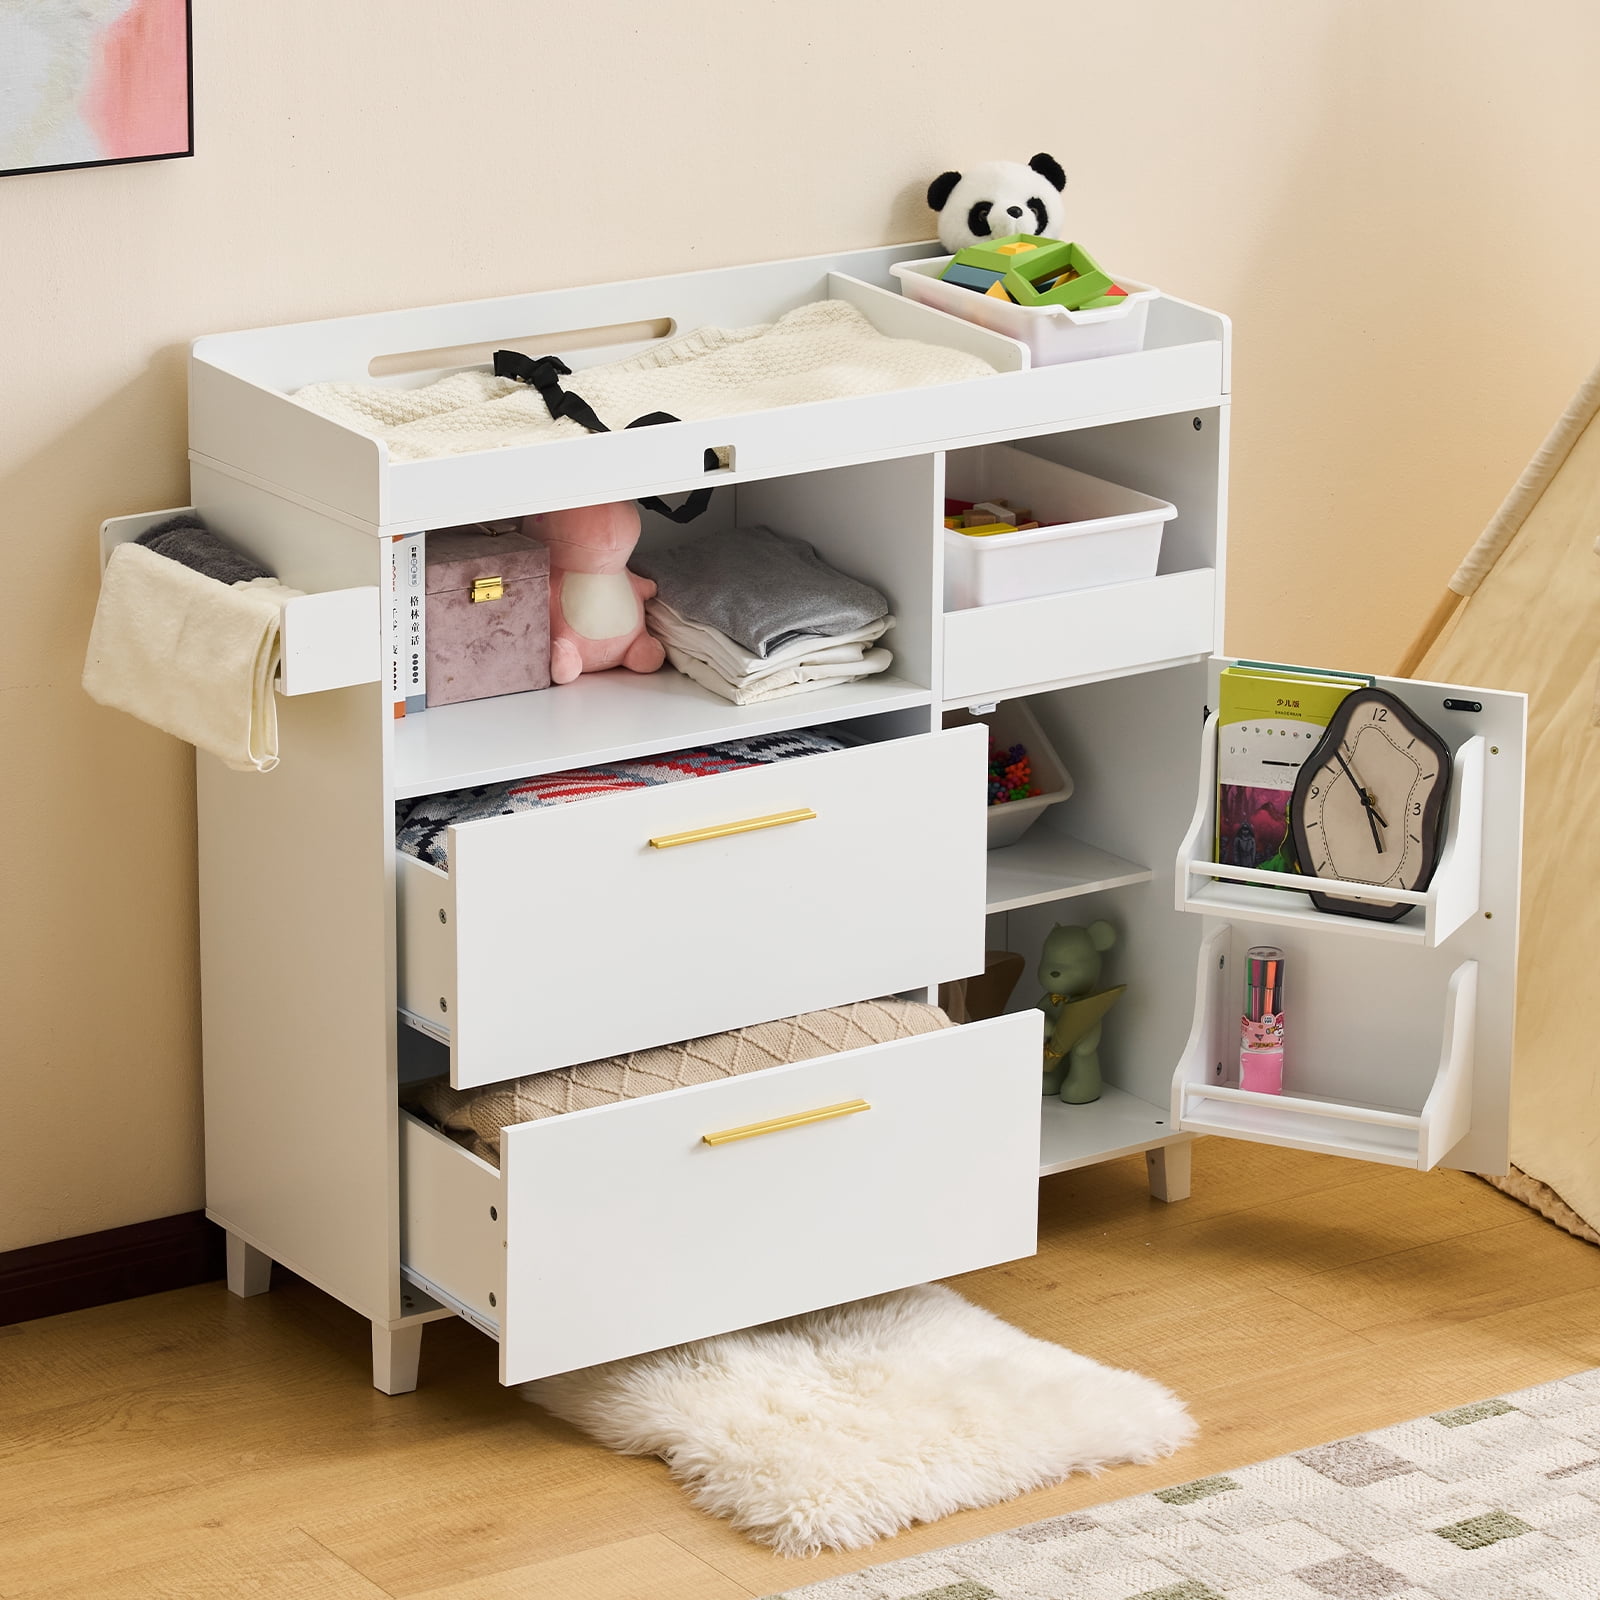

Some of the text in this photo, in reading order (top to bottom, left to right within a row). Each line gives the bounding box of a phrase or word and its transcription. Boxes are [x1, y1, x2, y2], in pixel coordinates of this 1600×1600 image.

[410, 596, 420, 646] 格林童话
[1276, 698, 1300, 709] 少儿版
[1372, 708, 1388, 722] 12
[1310, 786, 1320, 800] 9
[1412, 802, 1421, 816] 3
